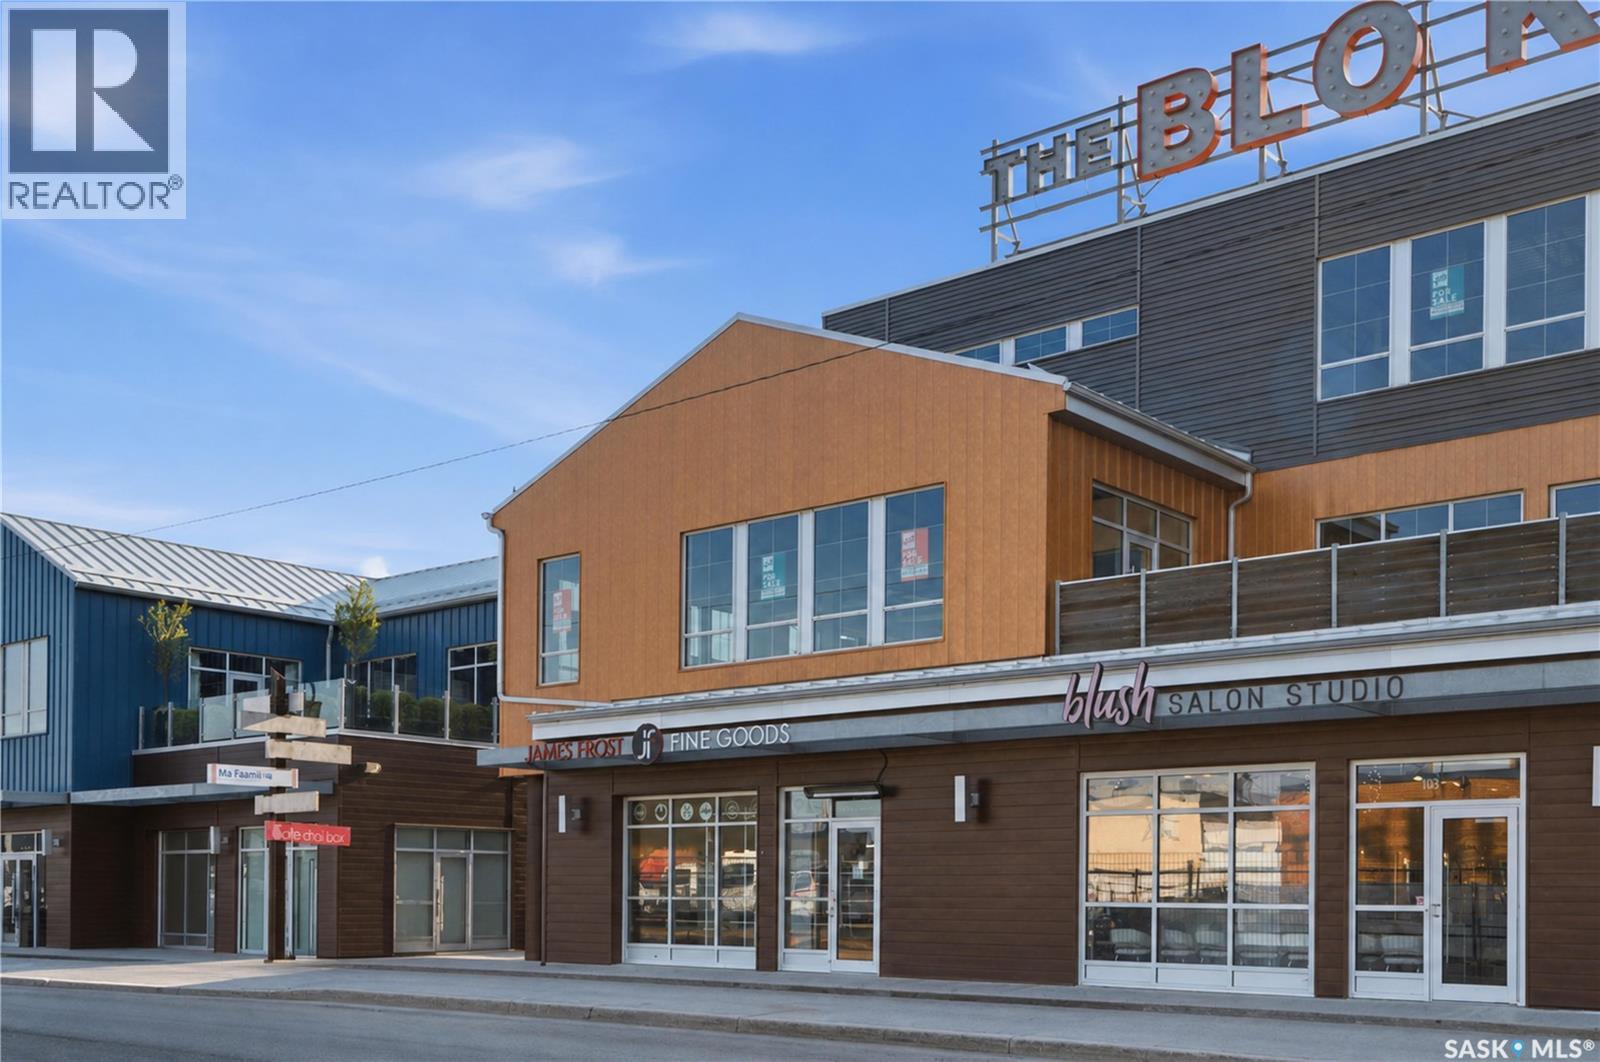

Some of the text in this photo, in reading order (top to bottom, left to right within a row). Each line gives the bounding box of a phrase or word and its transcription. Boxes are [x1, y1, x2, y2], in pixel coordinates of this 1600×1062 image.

[984, 117, 1114, 200] THE
[1062, 660, 1405, 729] blush SALON STUDIO
[524, 741, 573, 763] JAMES
[577, 737, 624, 760] FROST
[670, 730, 710, 752] FINE
[717, 723, 791, 748] GOODS
[218, 768, 232, 778] Ma
